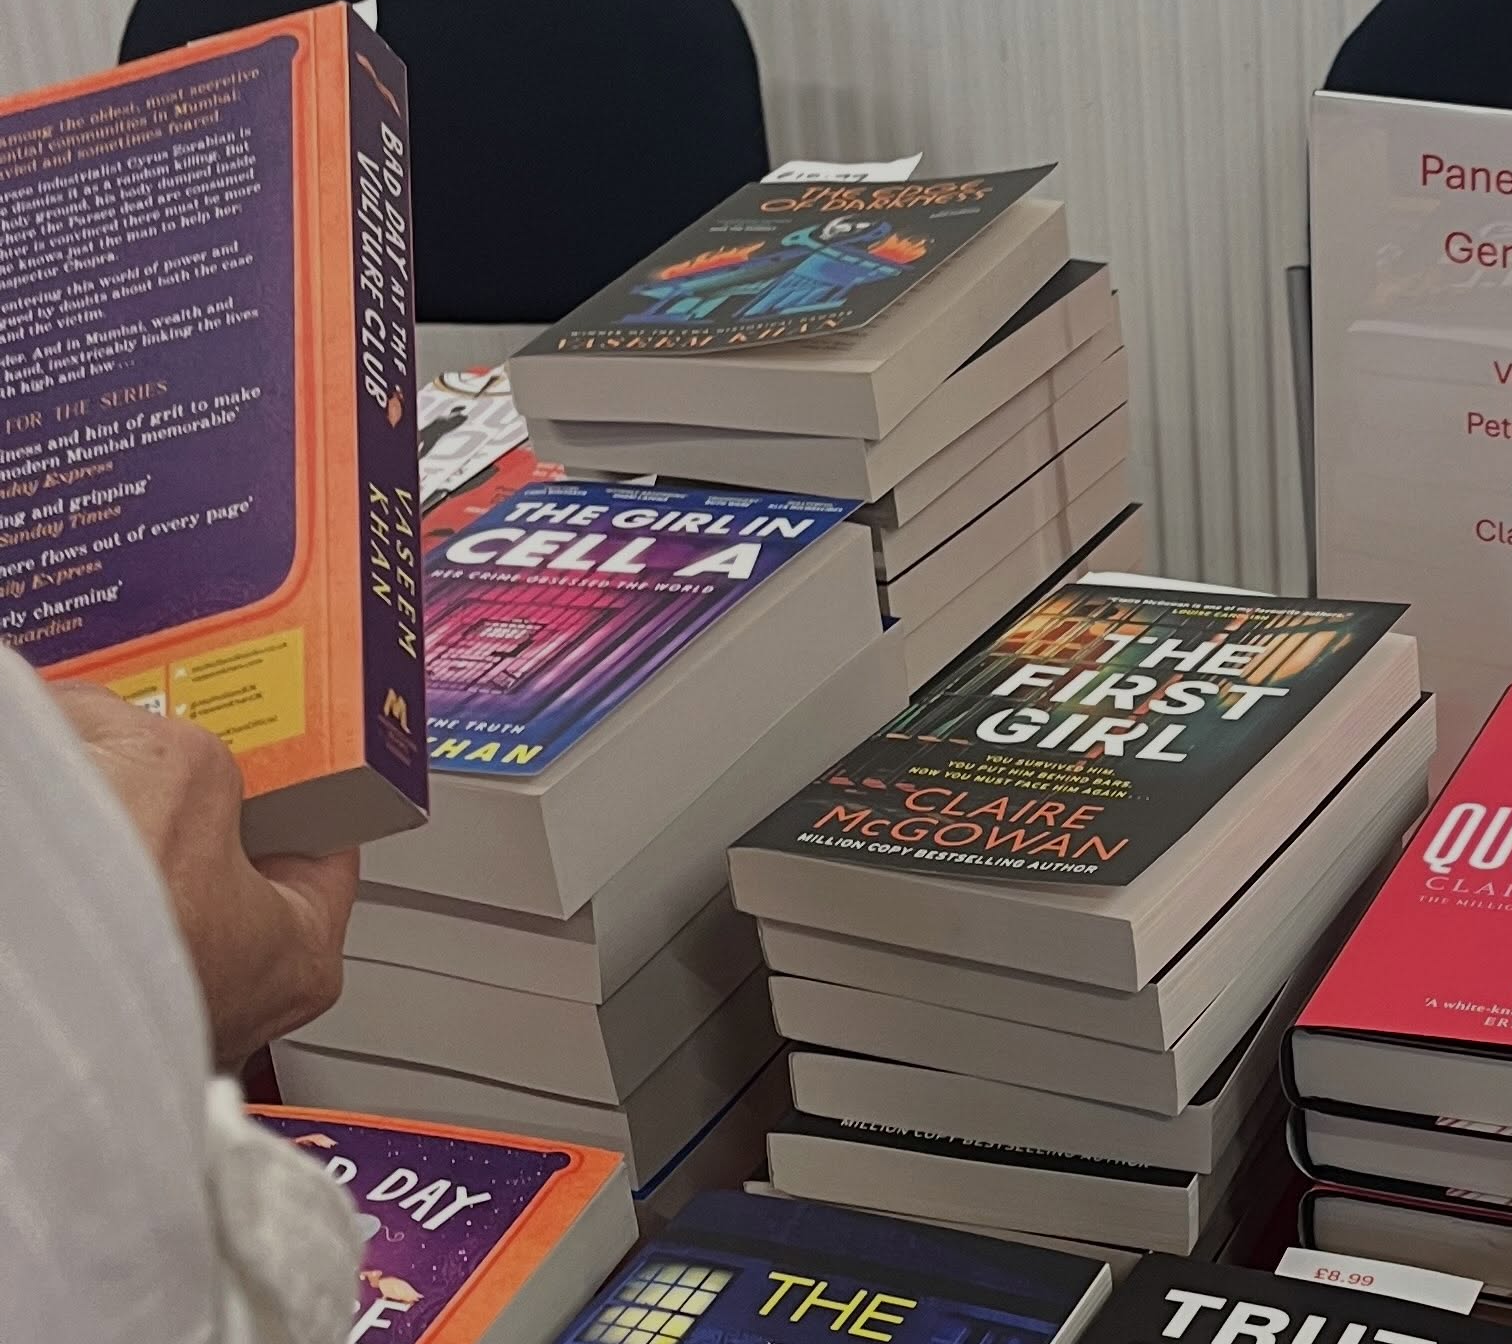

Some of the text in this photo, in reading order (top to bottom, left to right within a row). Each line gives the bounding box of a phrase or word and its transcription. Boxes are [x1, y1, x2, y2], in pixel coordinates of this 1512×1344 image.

[381, 121, 409, 377] BAD DAY AT THE
[357, 151, 388, 408] VULTURE CLUB
[369, 481, 392, 606] KHAN
[504, 502, 815, 539] THE GIRL IN
[394, 487, 417, 659] VASEEM
[444, 527, 763, 580] CELL A
[1095, 632, 1268, 677] THE
[991, 663, 1290, 721] FIRST
[975, 707, 1188, 763] GIRL
[812, 805, 1129, 861] McGOWAN
[904, 787, 1105, 830] CLAIRE
[797, 832, 1099, 875] MILLION COPY BESTSELLING AUTHOR
[366, 1167, 492, 1230] DAY
[1313, 1266, 1375, 1289] £8.99
[756, 1269, 920, 1344] THE
